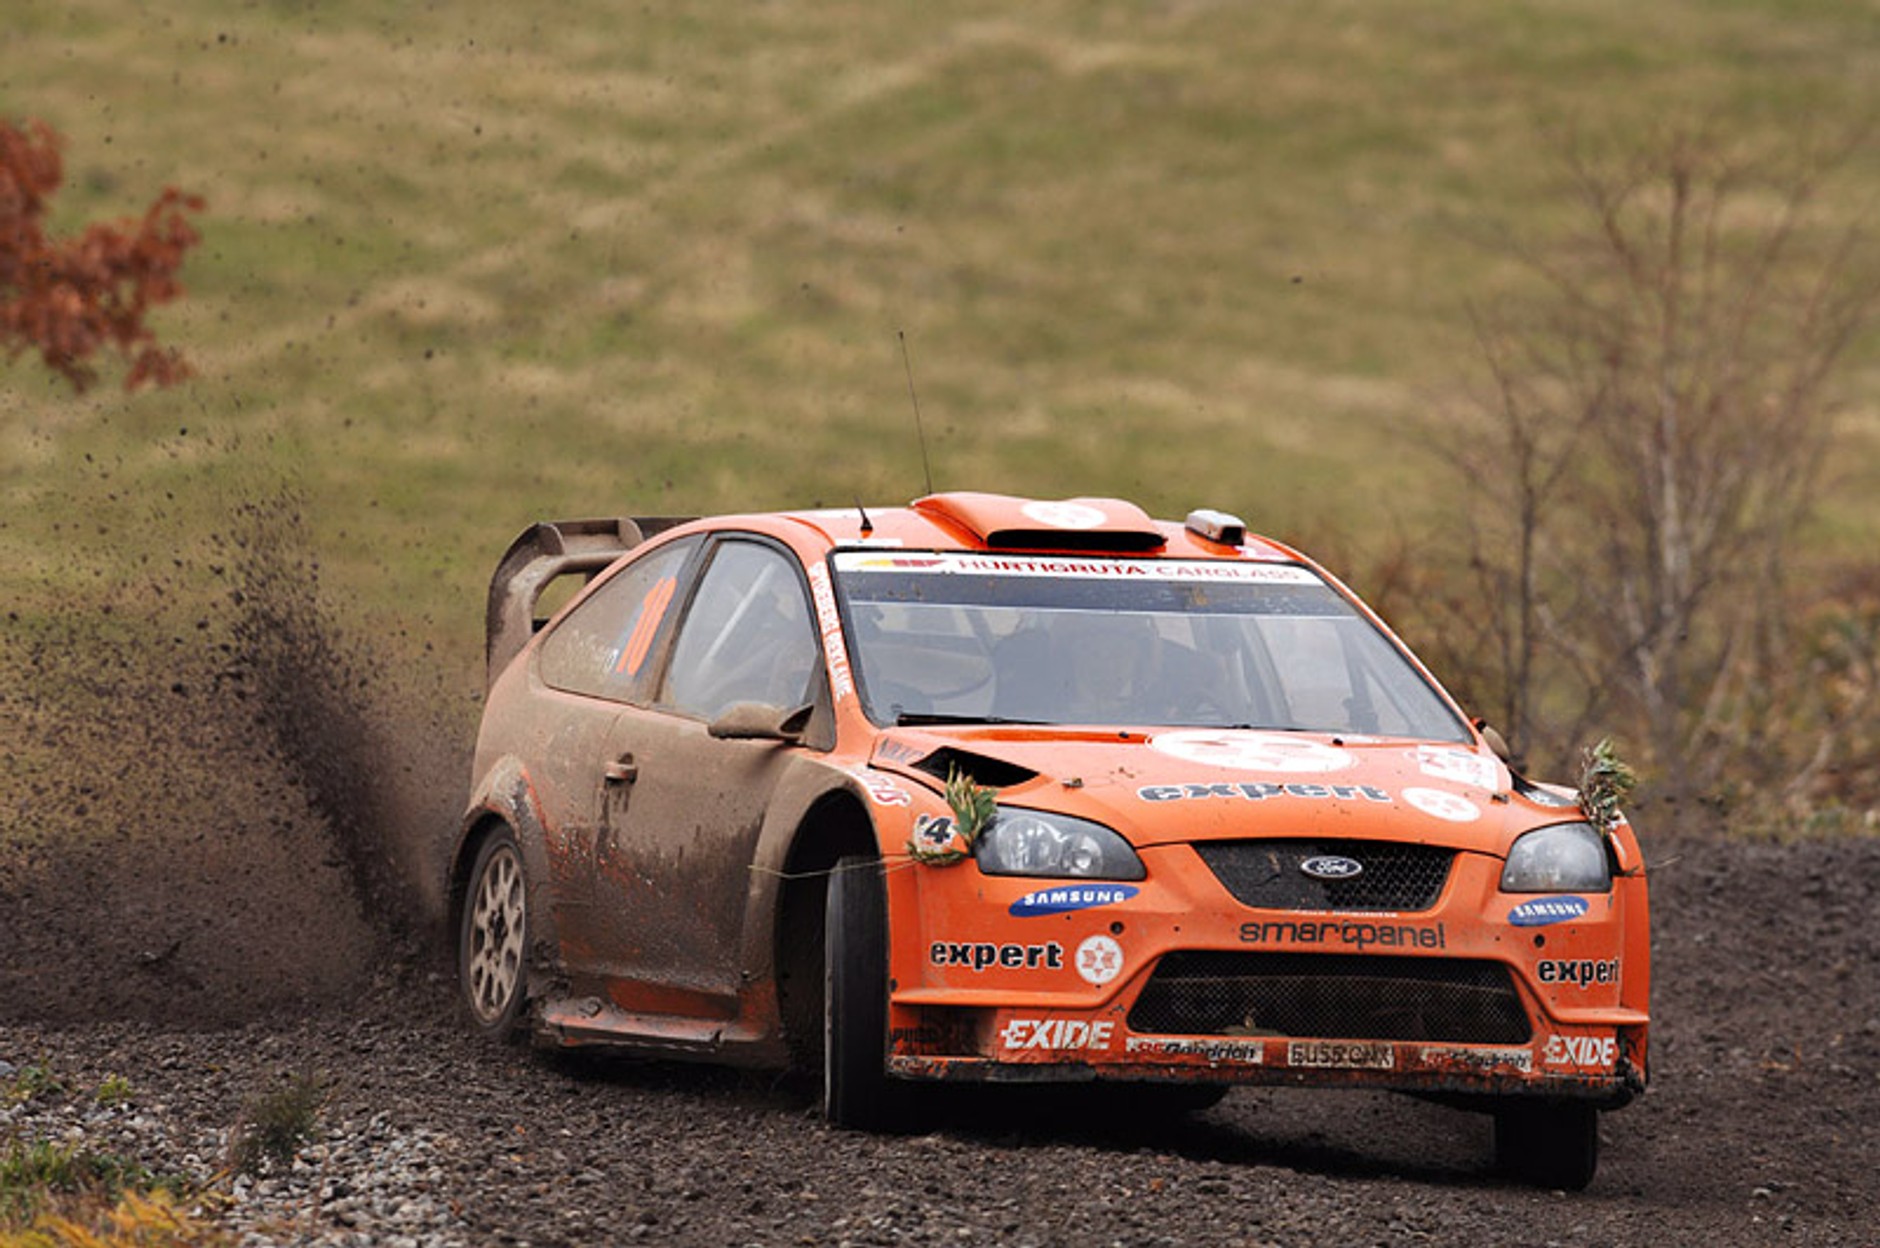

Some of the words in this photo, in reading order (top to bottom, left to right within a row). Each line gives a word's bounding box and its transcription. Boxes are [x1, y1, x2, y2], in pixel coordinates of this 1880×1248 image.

[958, 559, 1147, 575] HURTIGRUTA
[1139, 782, 1391, 801] expert
[1024, 889, 1125, 906] SAMSUNG
[1514, 903, 1586, 918] SAMSUNG
[1239, 921, 1446, 950] smartpanel
[930, 942, 1063, 969] expert
[1001, 1019, 1114, 1050] EXIDE
[1543, 1035, 1616, 1066] EXIDE
